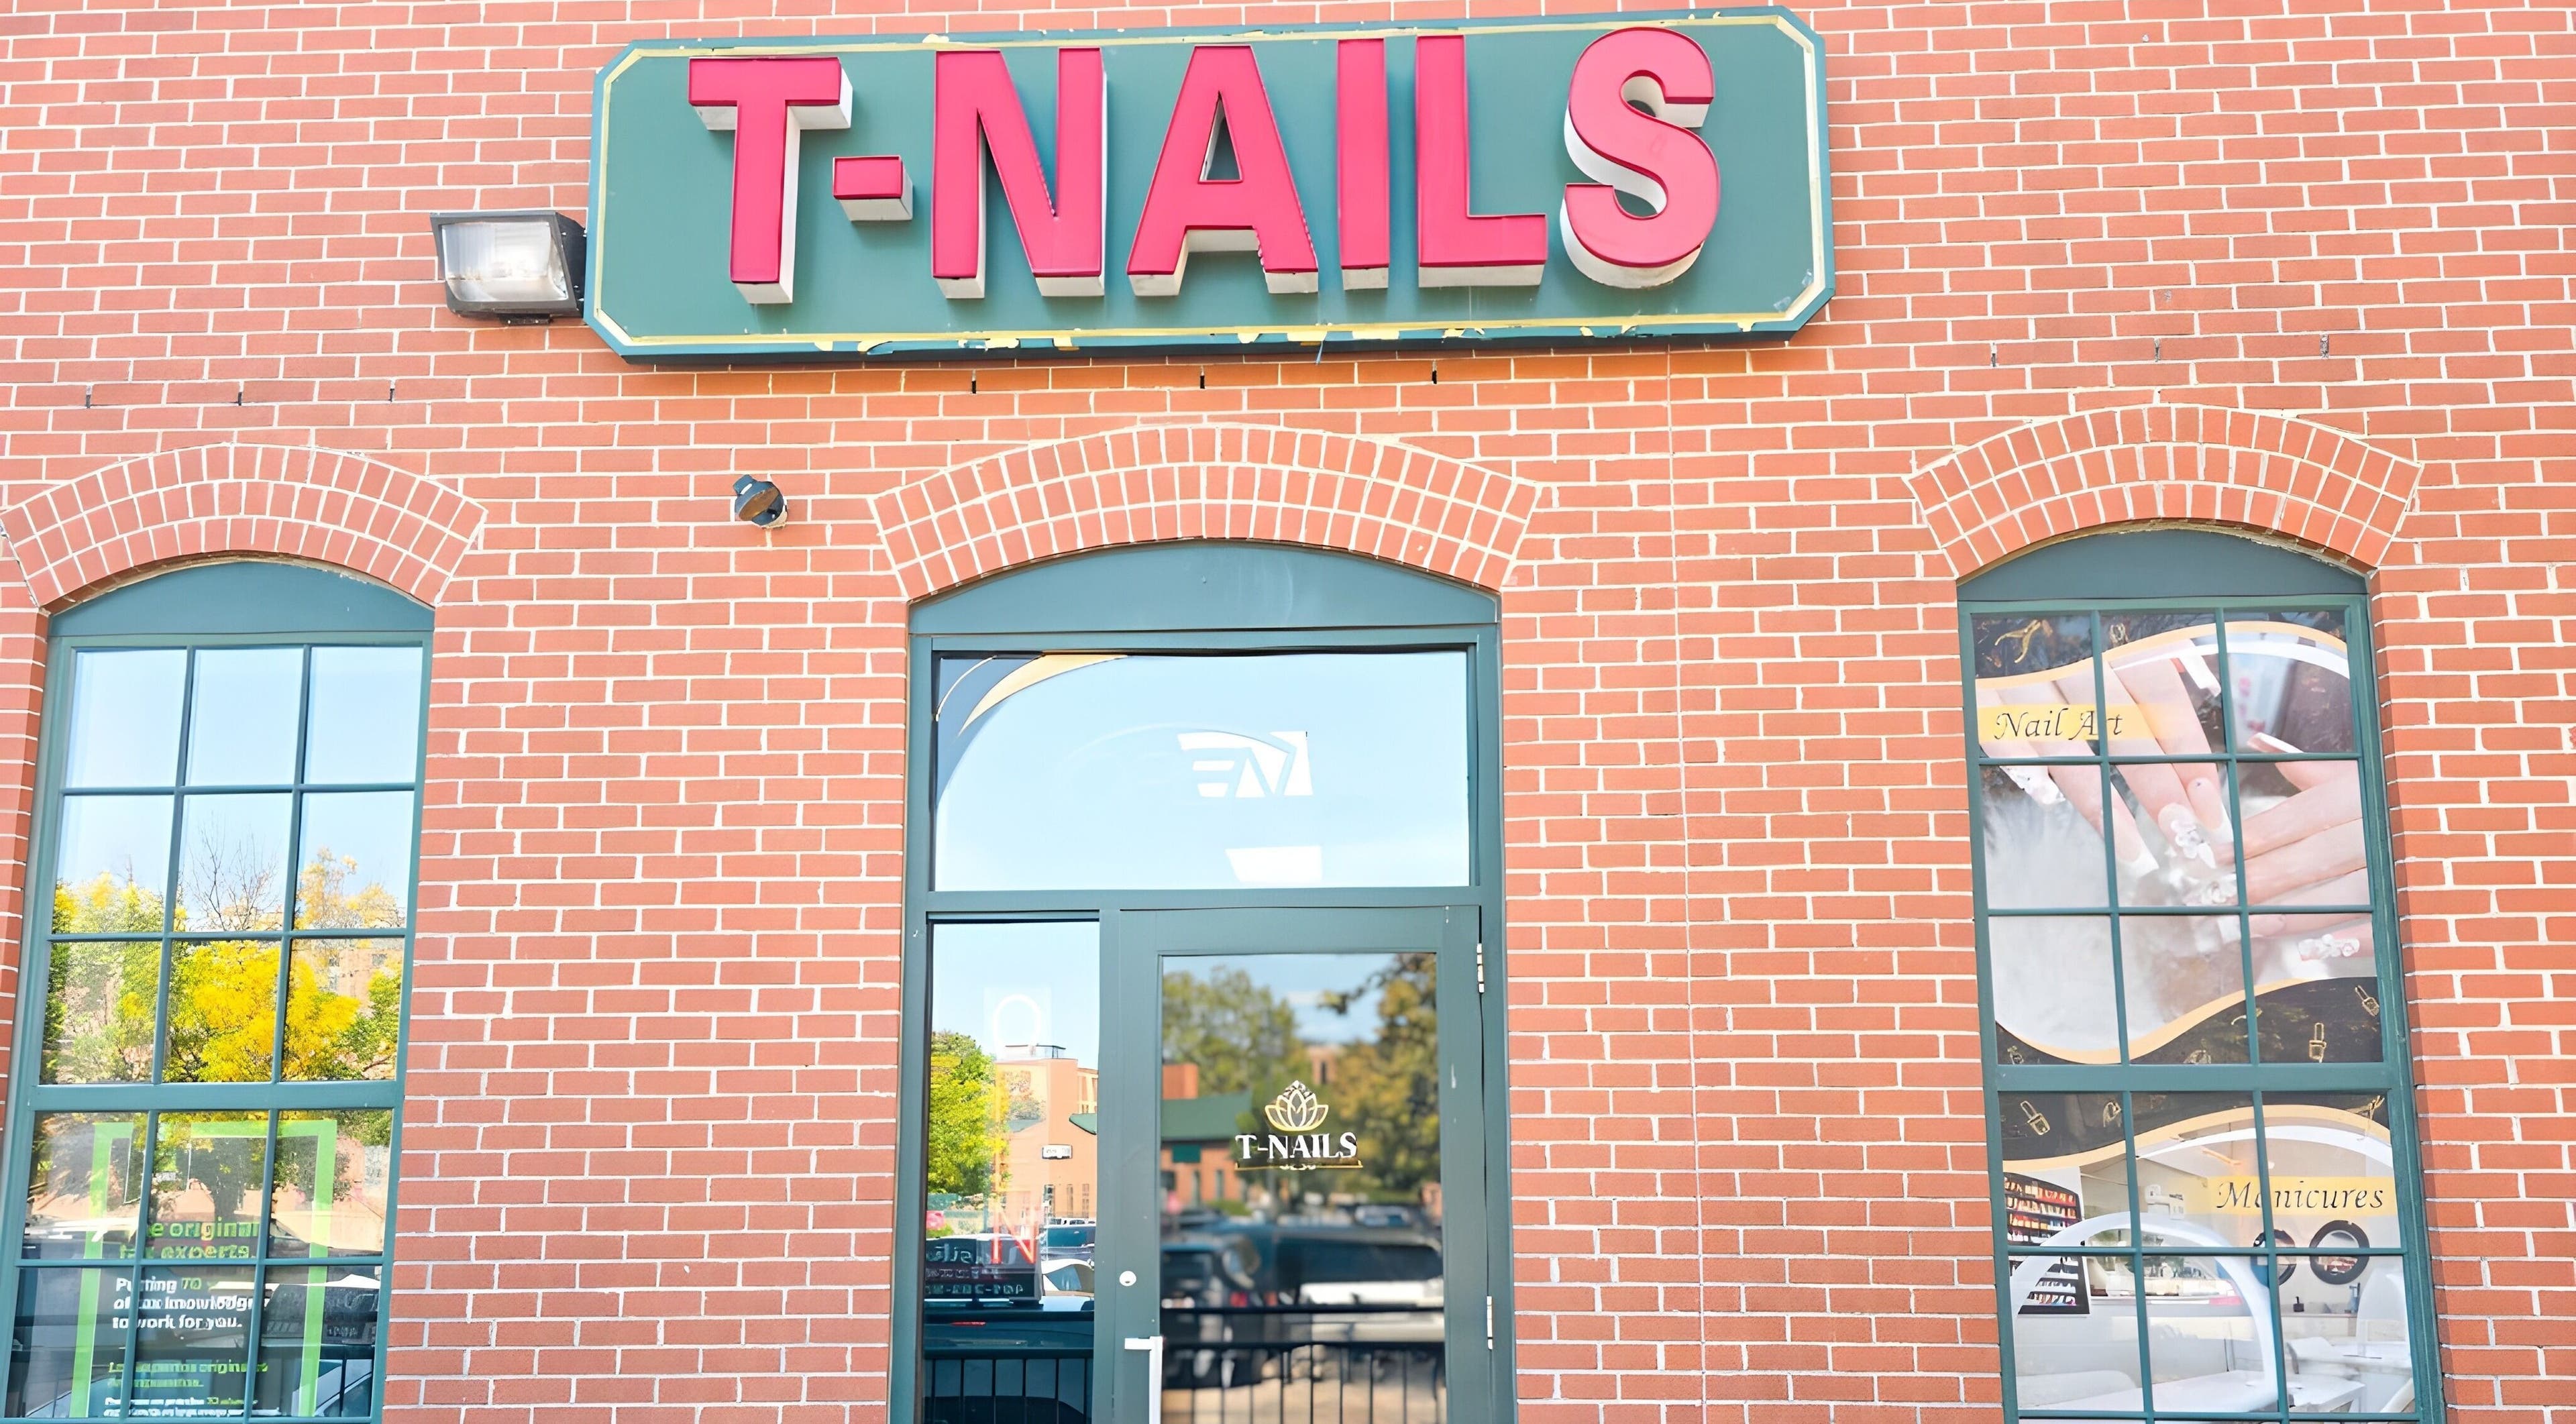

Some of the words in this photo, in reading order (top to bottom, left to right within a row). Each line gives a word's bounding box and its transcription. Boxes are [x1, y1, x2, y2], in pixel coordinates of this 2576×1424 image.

[688, 27, 1722, 303] T-NAILS
[1994, 708, 2069, 740] Nail
[2068, 710, 2123, 741] At
[1234, 1132, 1357, 1159] T-NAILS
[178, 1314, 203, 1329] for
